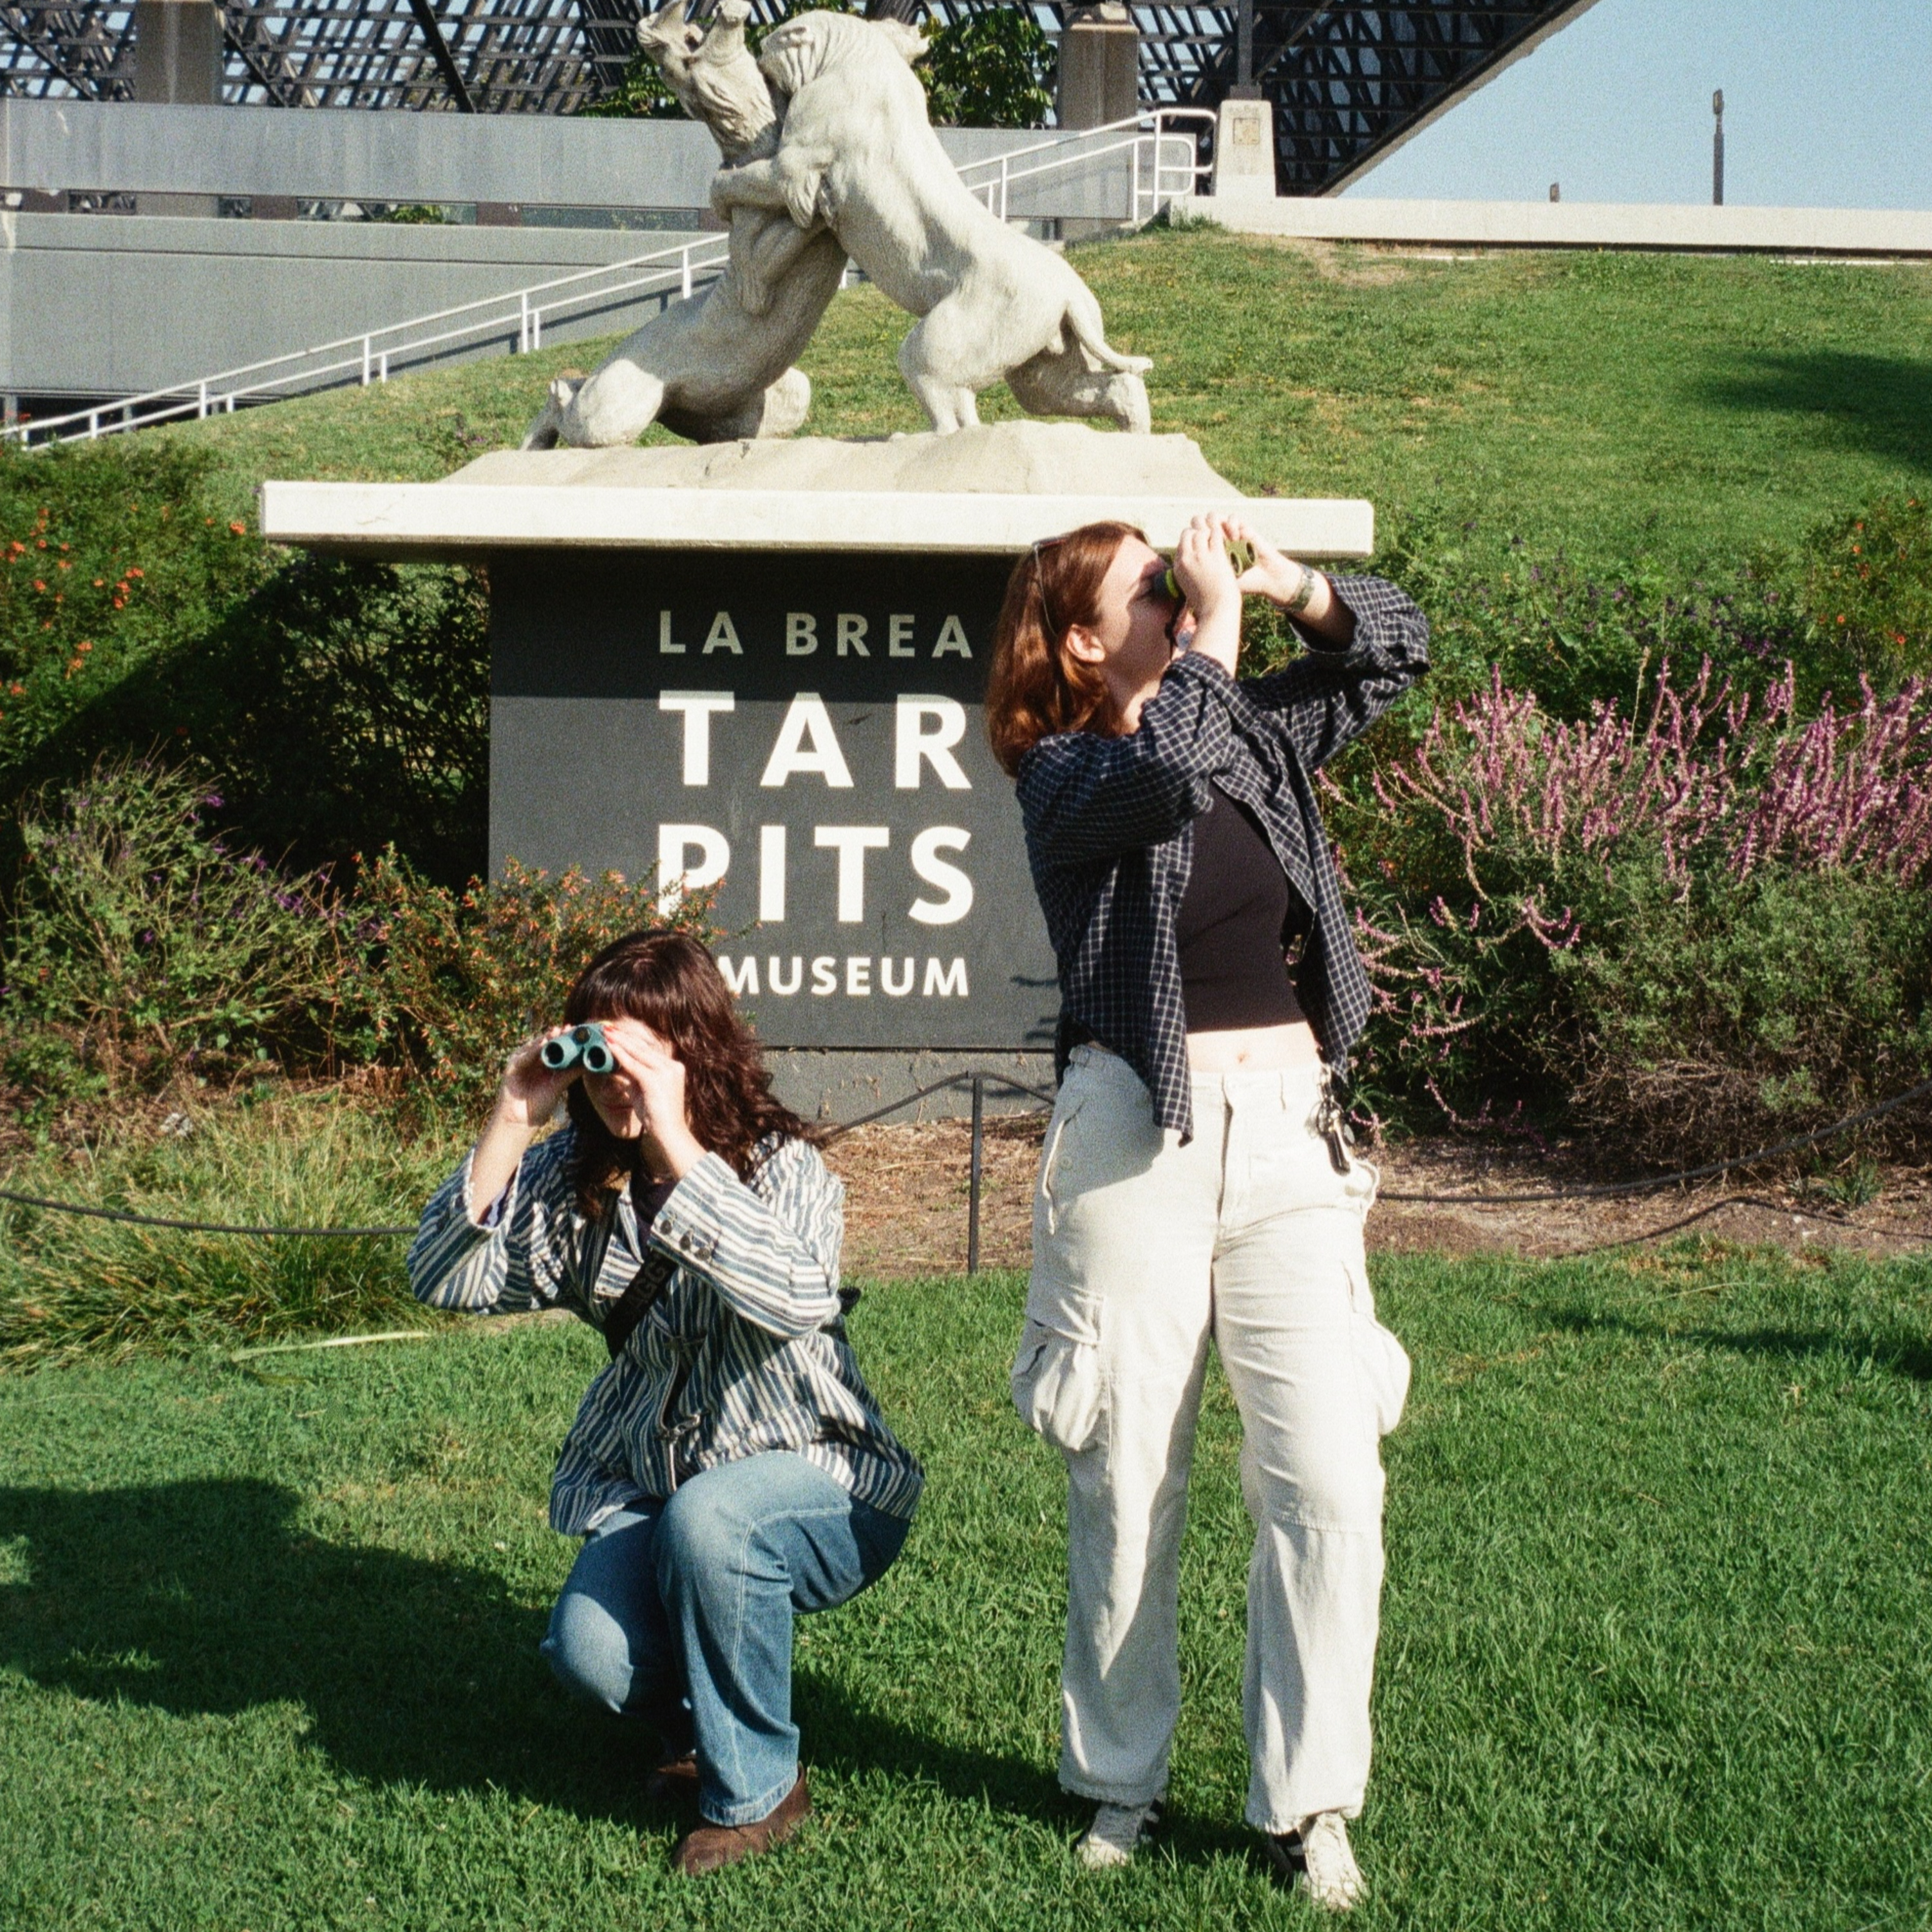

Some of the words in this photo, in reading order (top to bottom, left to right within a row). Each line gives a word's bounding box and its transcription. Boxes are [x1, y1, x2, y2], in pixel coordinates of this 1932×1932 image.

[659, 611, 743, 654] LA
[786, 612, 973, 658] BREA
[658, 690, 972, 789] TAR
[658, 824, 974, 925] PITS
[717, 956, 969, 996] MUSEUM
